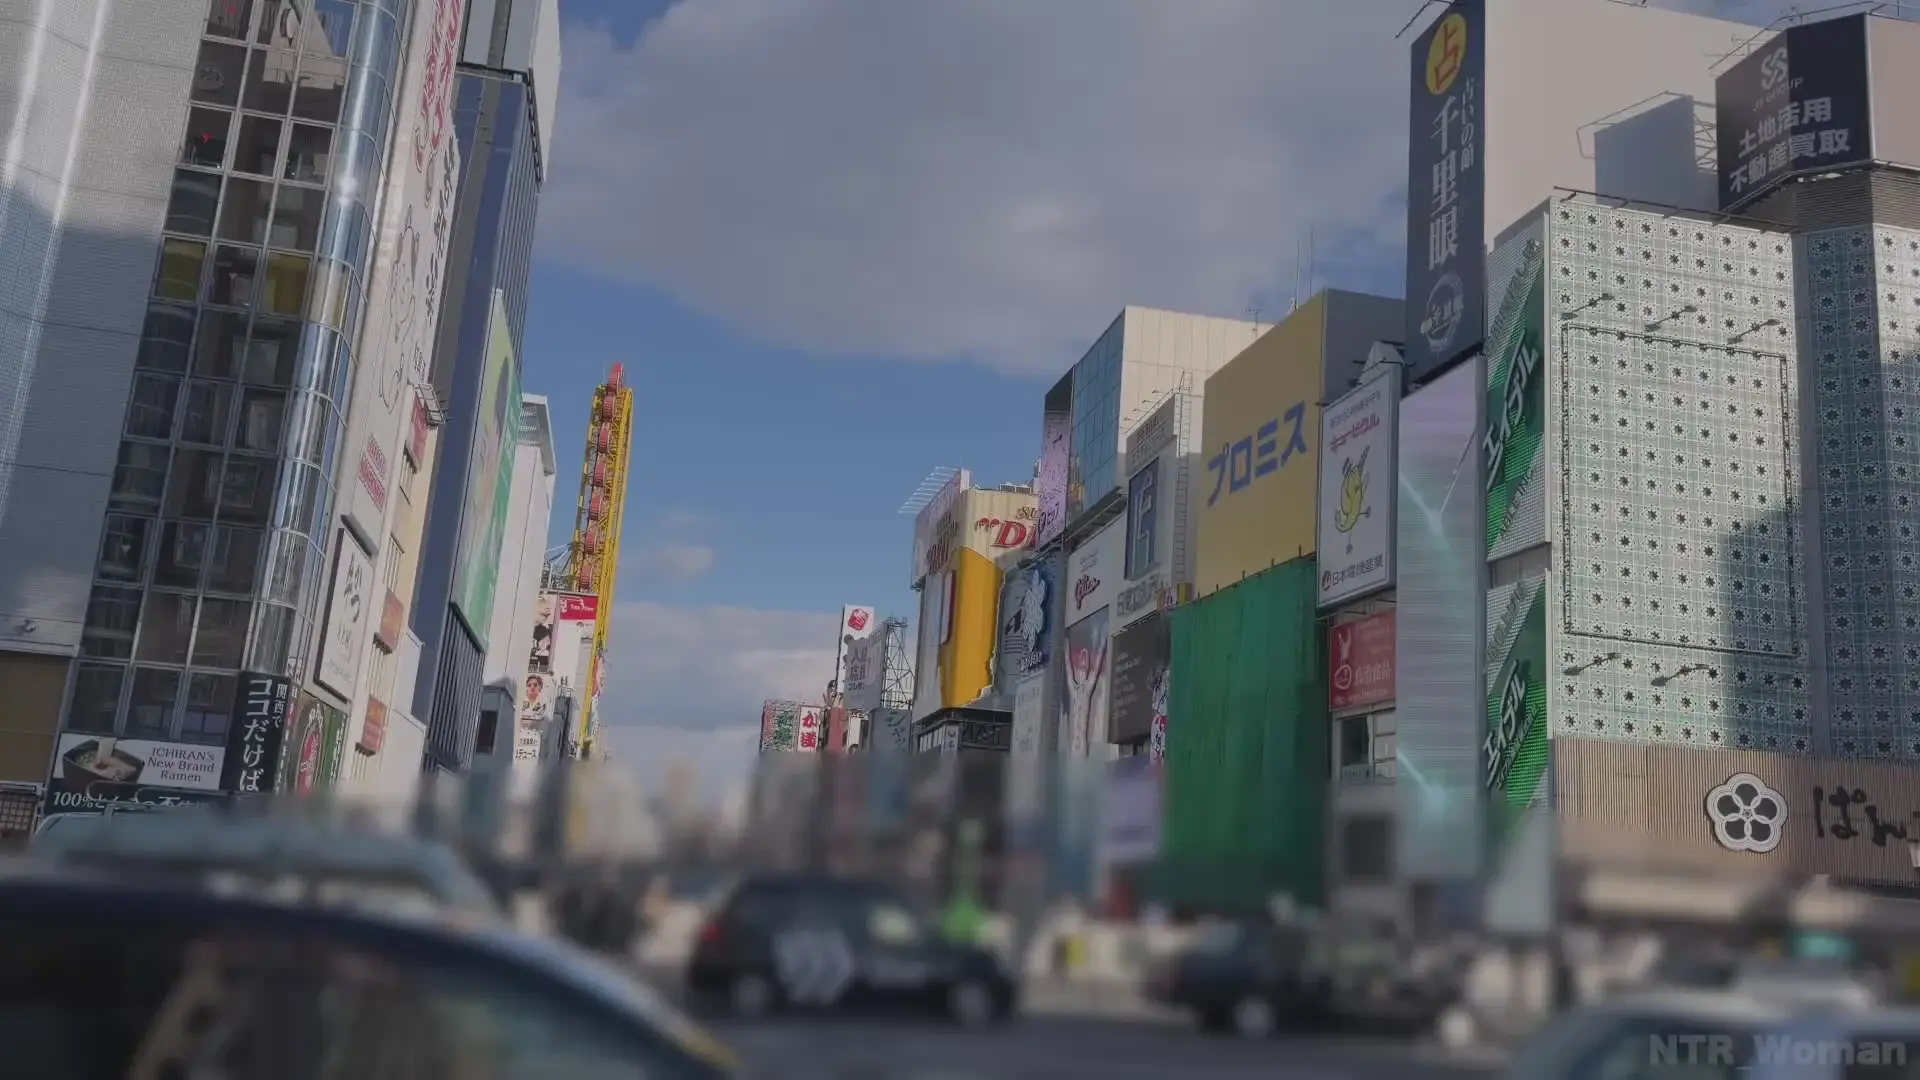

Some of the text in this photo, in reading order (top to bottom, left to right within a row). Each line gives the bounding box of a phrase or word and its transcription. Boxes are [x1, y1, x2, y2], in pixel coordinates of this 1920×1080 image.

[1433, 22, 1461, 91] 占
[1728, 128, 1850, 194] 不動産買取
[1737, 96, 1832, 159] 土地活用
[1429, 95, 1461, 272] 千里眼
[1482, 327, 1540, 493] エイブル
[1207, 400, 1308, 508] プロミス
[151, 746, 216, 761] ICHIRAN's
[239, 678, 273, 792] ココだけば
[1483, 658, 1526, 789] エイブル
[147, 757, 216, 773] New Brand
[160, 771, 202, 783] Ramen
